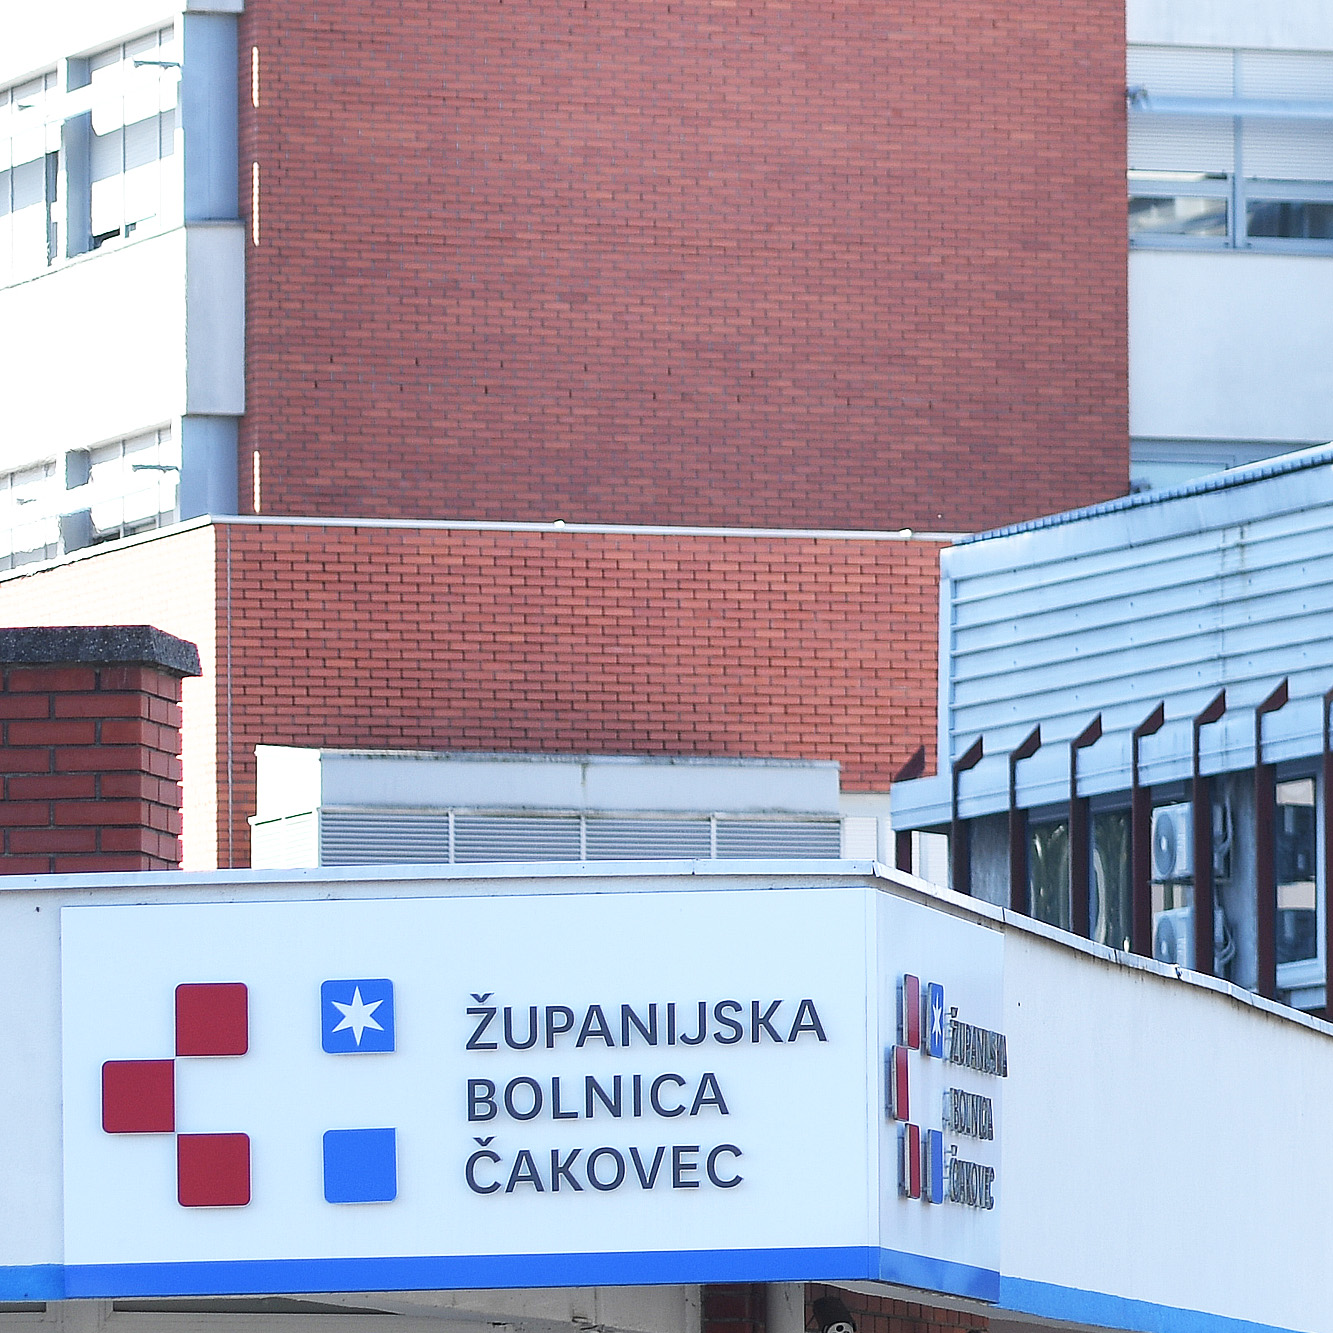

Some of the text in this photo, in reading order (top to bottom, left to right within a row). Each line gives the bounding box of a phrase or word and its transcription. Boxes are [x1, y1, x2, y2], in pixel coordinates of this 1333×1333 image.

[465, 992, 827, 1051] ŽUPANIJSKA
[467, 1072, 729, 1122] BOLNICA
[465, 1136, 744, 1195] ČAKOVEC
